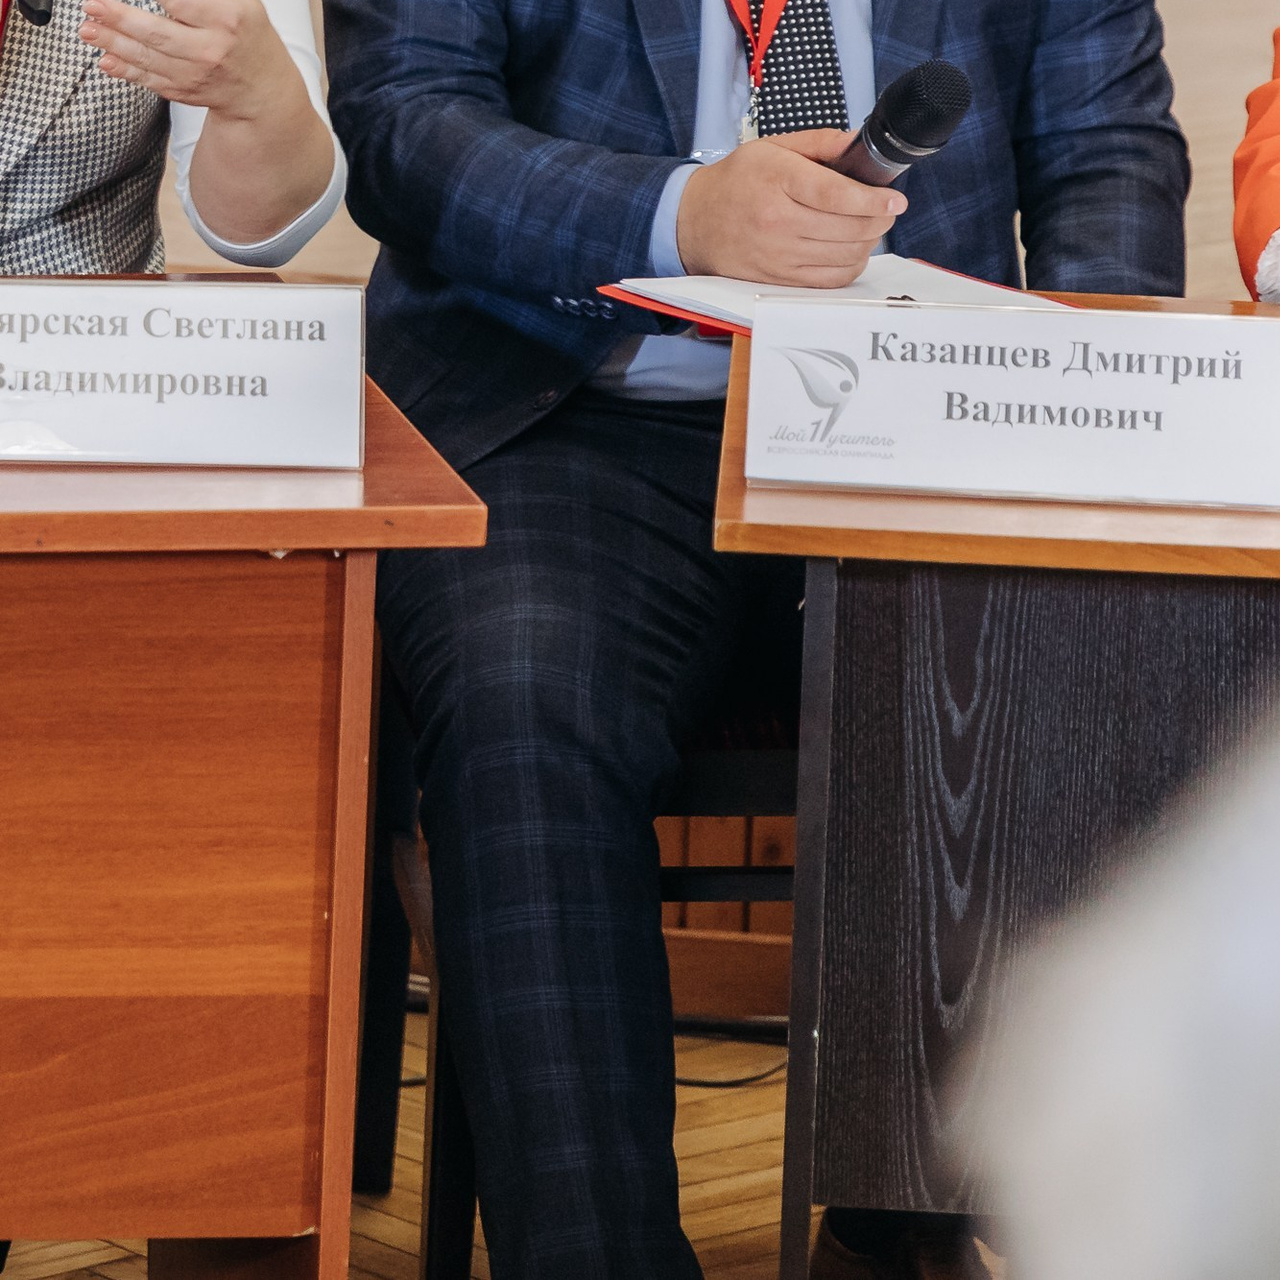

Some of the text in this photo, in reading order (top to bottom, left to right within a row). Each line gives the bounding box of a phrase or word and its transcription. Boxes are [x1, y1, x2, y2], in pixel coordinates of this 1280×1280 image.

[142, 307, 328, 342] Светлана
[868, 331, 1244, 385] Казанцев Дмитрий
[942, 390, 1164, 431] Вадимович
